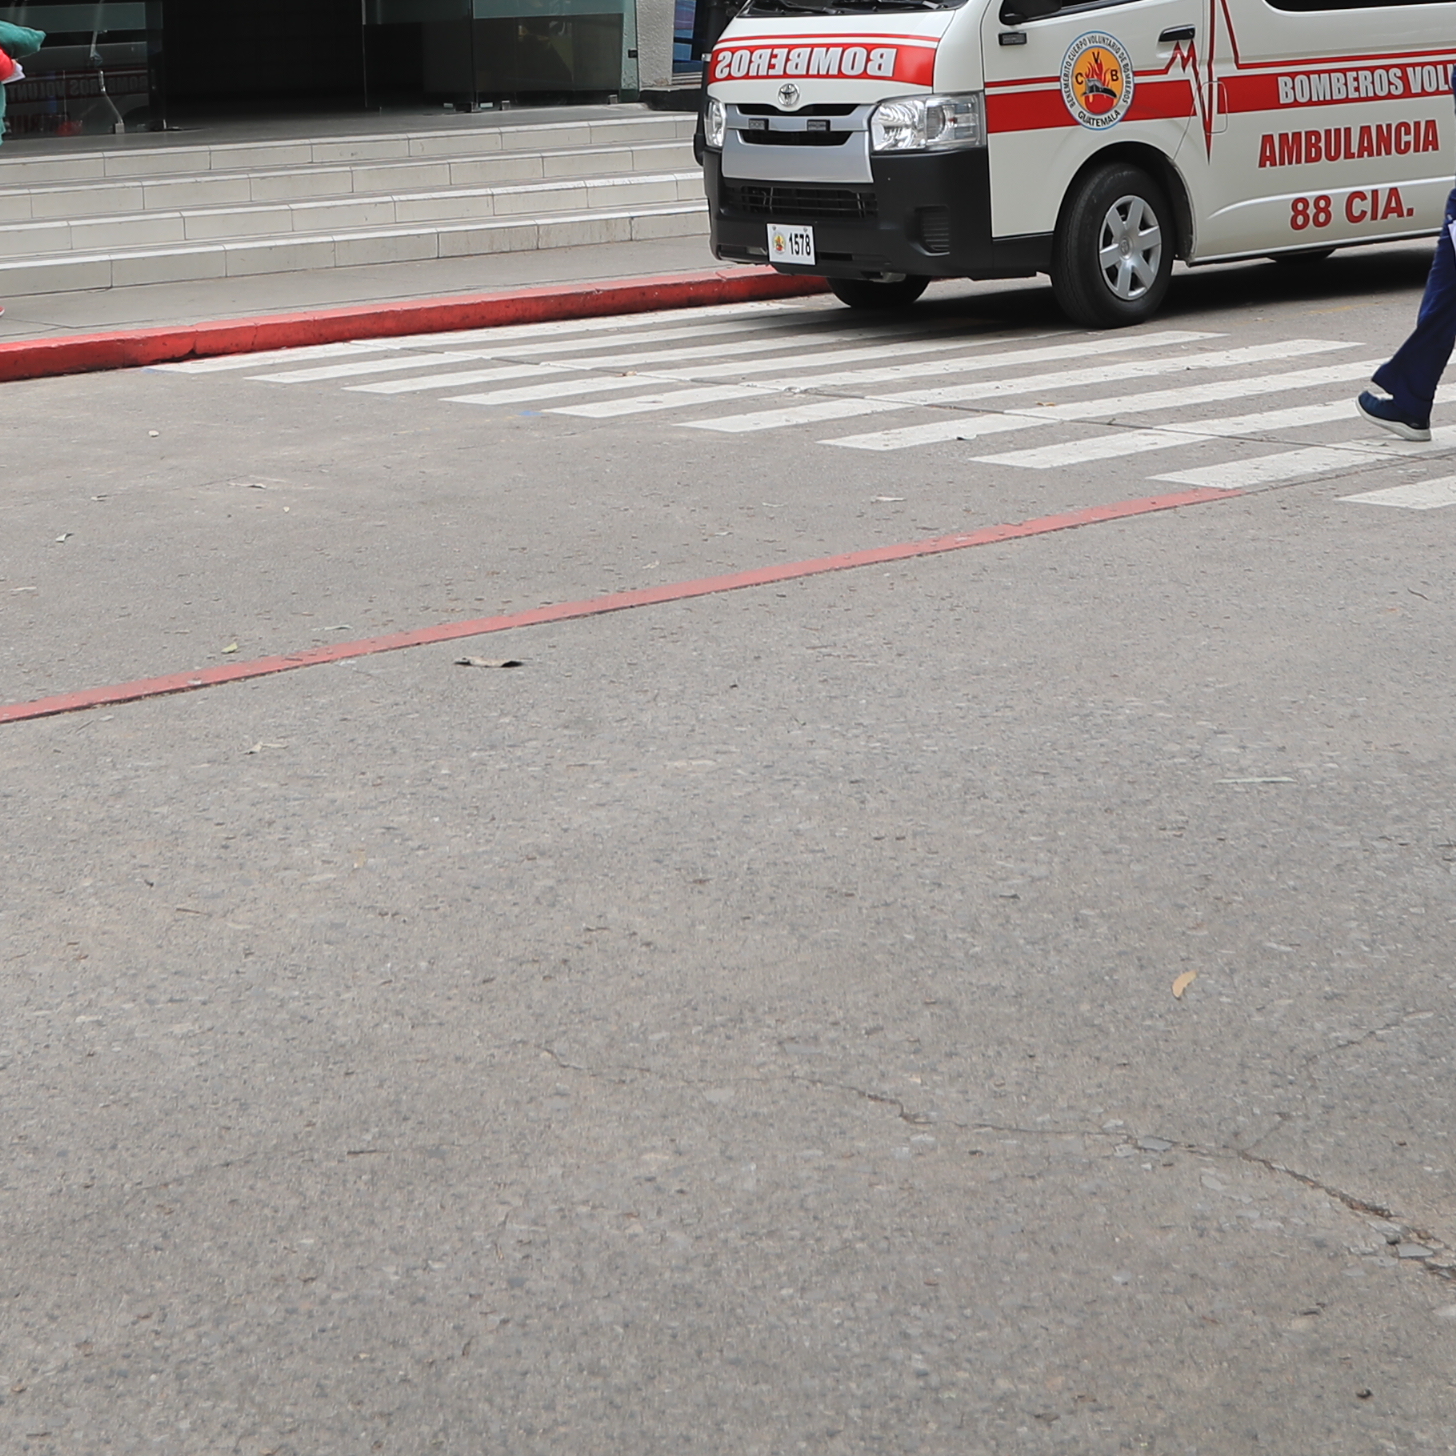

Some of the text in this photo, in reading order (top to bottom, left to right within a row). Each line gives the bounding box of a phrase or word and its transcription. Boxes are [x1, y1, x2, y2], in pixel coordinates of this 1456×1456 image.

[1068, 38, 1088, 62] CUERPO
[1087, 35, 1121, 54] VOLUNTARIO
[1118, 50, 1126, 63] DE
[1122, 62, 1132, 105] BOMBEROS
[1092, 51, 1100, 65] V
[1075, 69, 1119, 85] C B
[1277, 67, 1404, 104] BOMBEROS
[1078, 109, 1121, 127] GUATEMALA
[1258, 119, 1440, 168] AMBULANCIA
[1290, 187, 1414, 231] 88 CIA.
[789, 232, 811, 256] 1578
